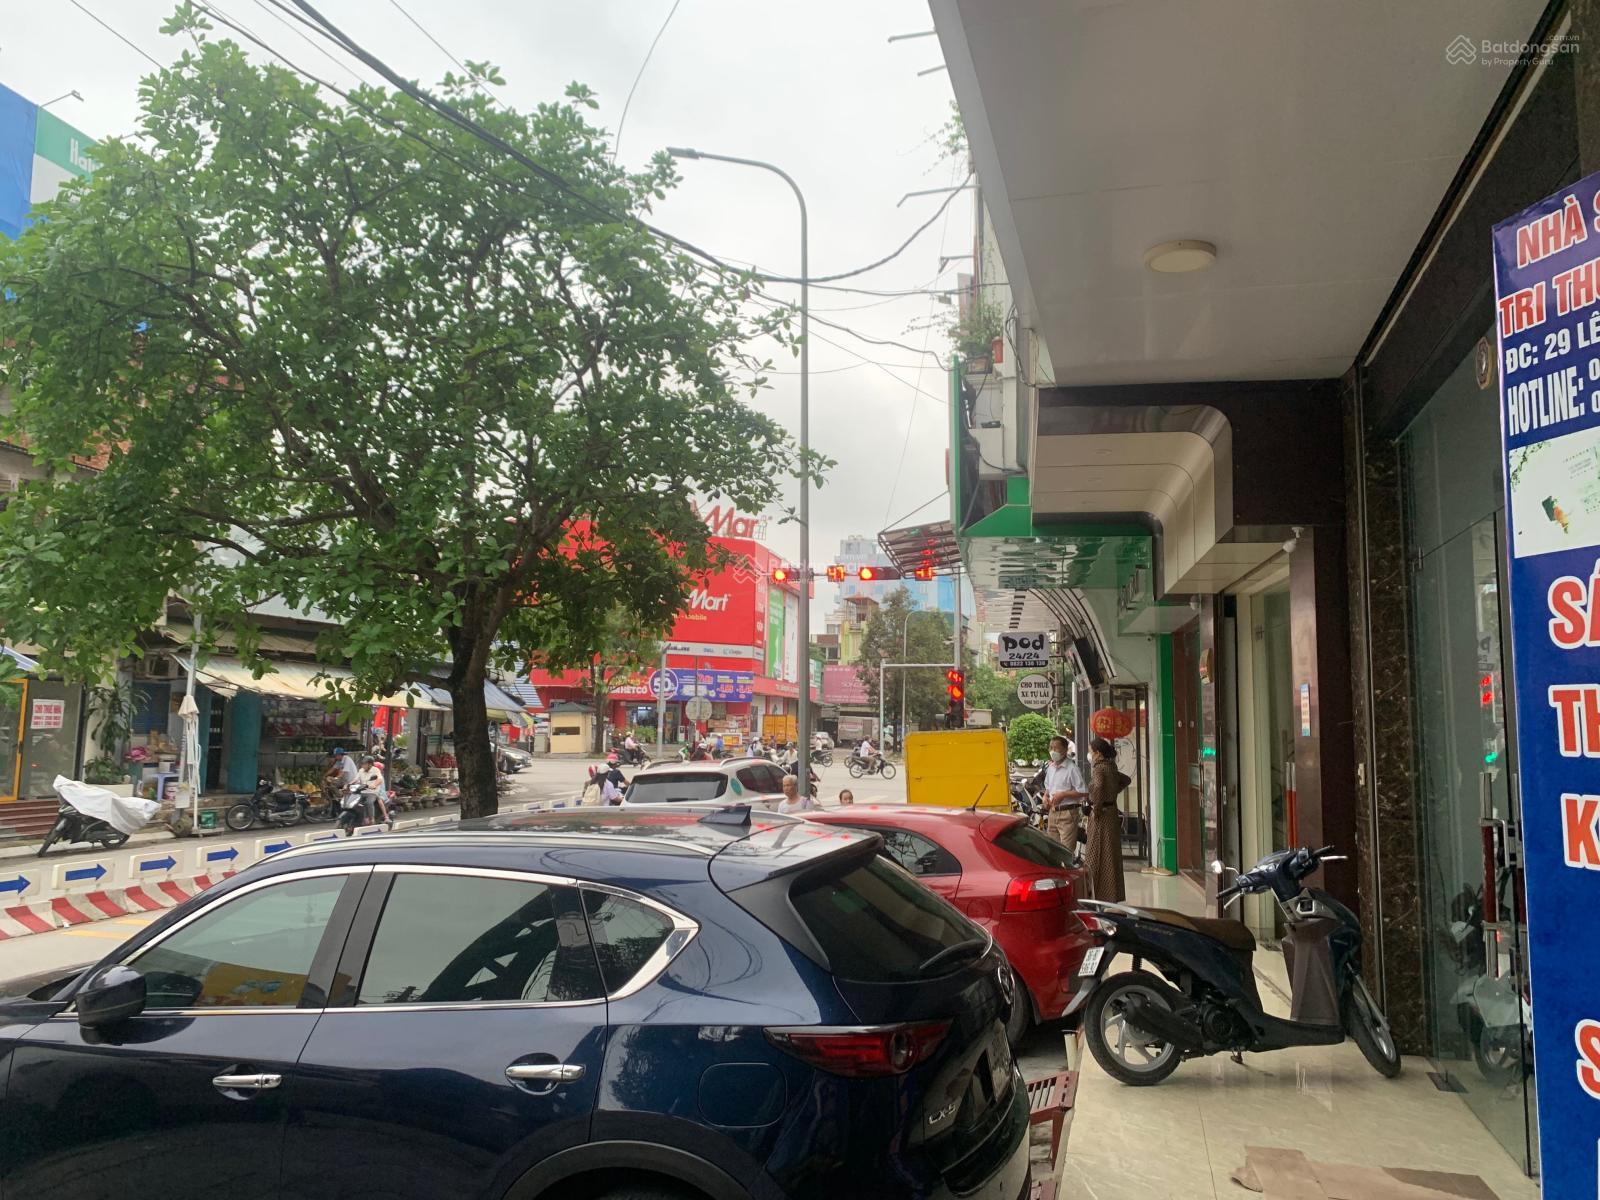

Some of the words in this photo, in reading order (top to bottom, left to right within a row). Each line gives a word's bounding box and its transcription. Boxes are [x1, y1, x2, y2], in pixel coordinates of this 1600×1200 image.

[1517, 194, 1587, 269] NHÀ
[1499, 281, 1546, 338] TRI
[1552, 256, 1600, 317] TH
[1505, 343, 1539, 375] ĐC:
[1544, 328, 1571, 360] 29
[1508, 366, 1585, 436] HOTLINE:
[1002, 634, 1044, 652] pod
[1009, 652, 1039, 660] 24/24
